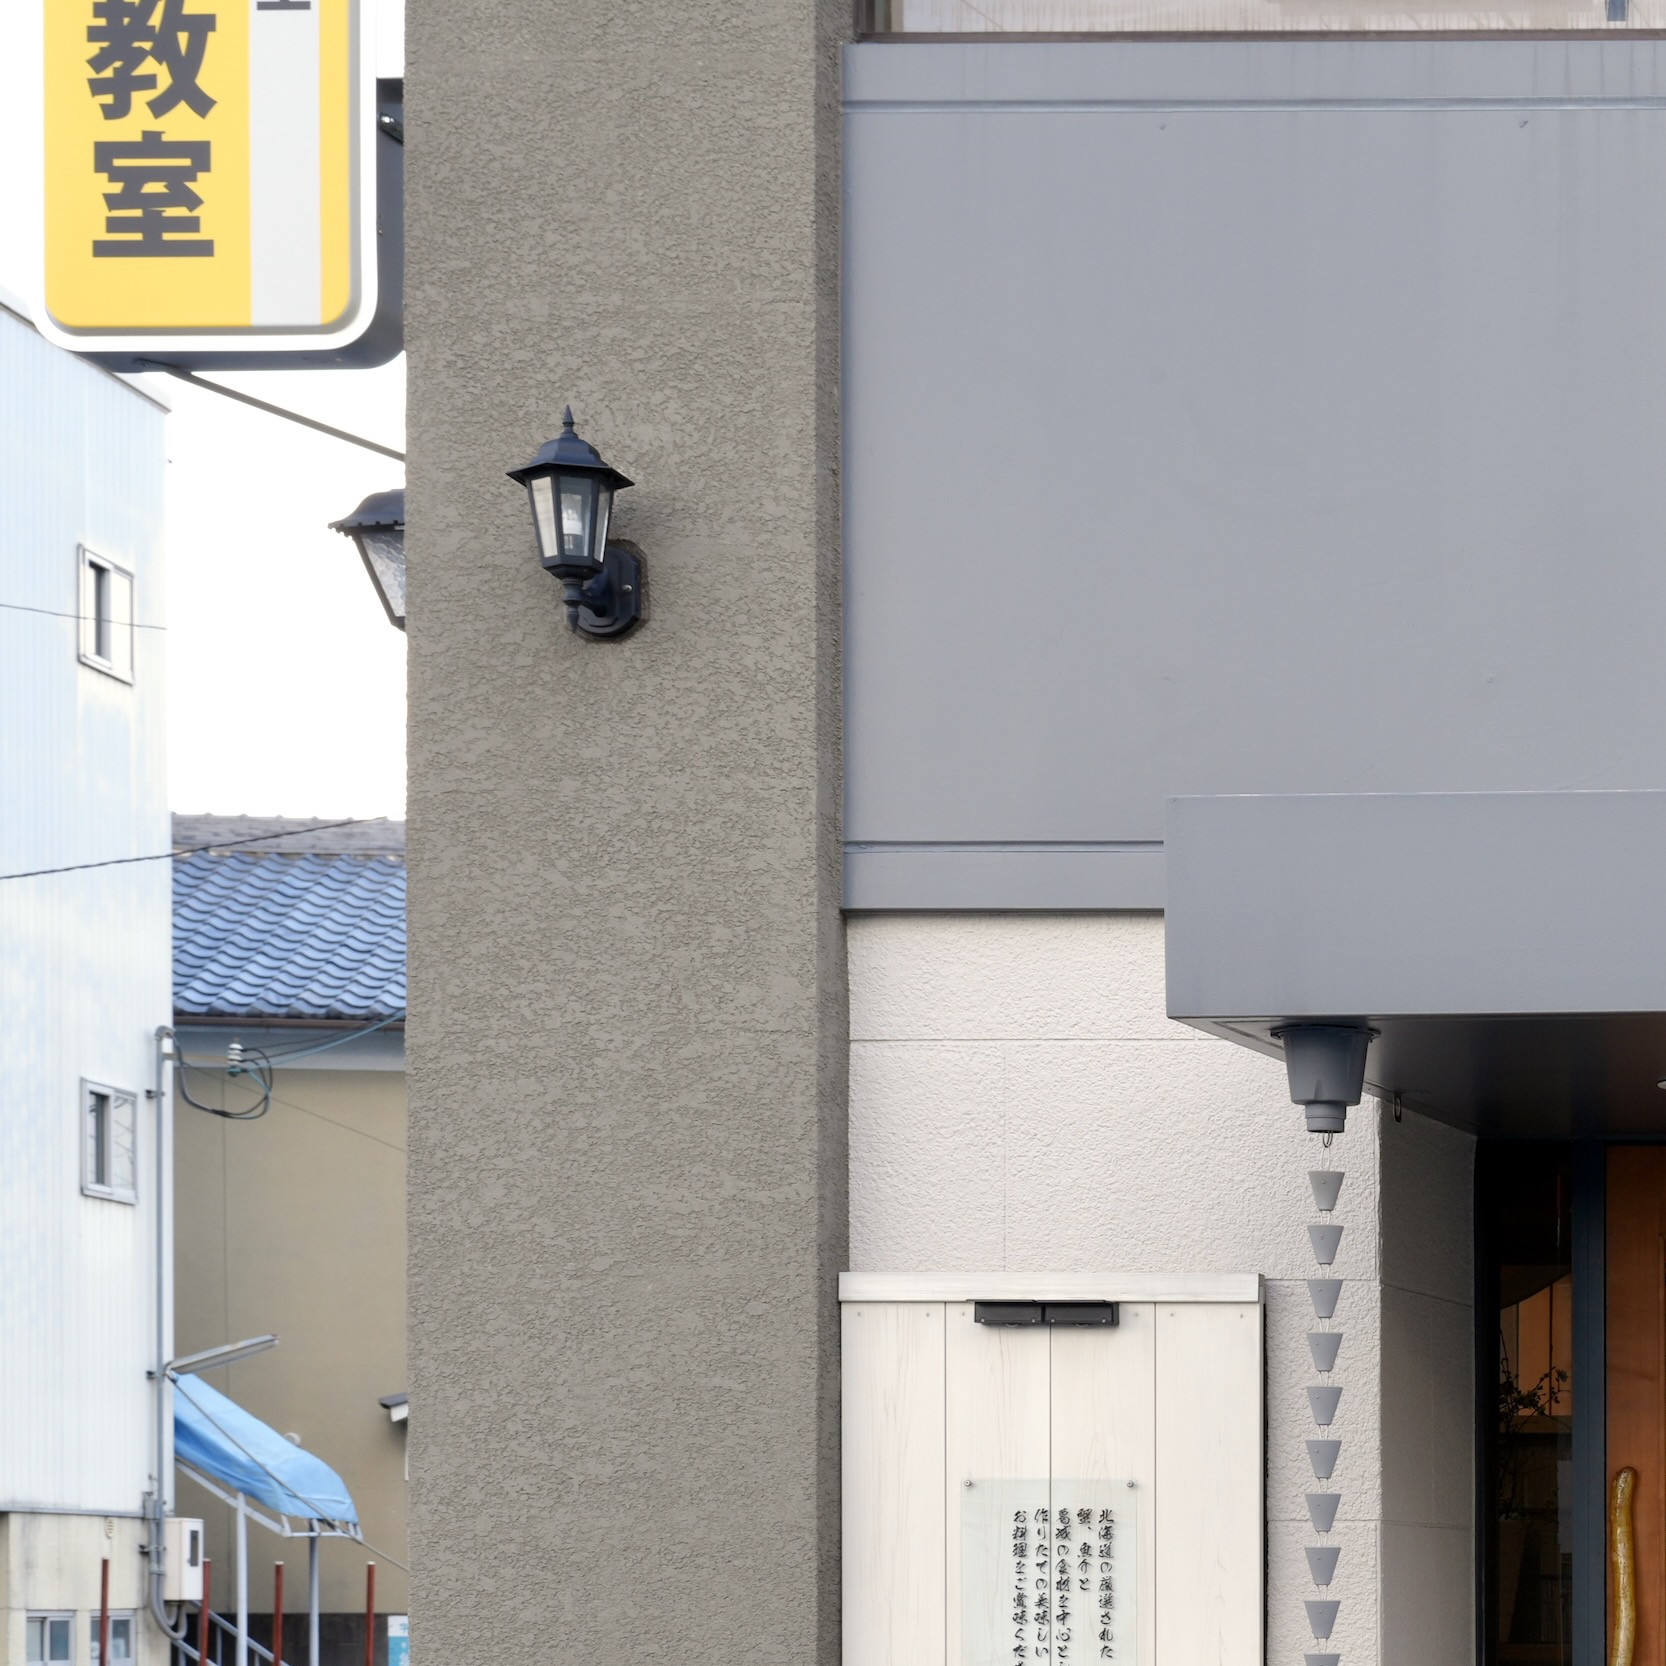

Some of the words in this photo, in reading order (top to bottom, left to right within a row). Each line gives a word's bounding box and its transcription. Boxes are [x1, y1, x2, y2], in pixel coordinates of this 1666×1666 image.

[86, 0, 218, 258] 教室
[1034, 1508, 1050, 1658] 作りたての美味しい
[1098, 1508, 1115, 1659] 北海道の厳選された
